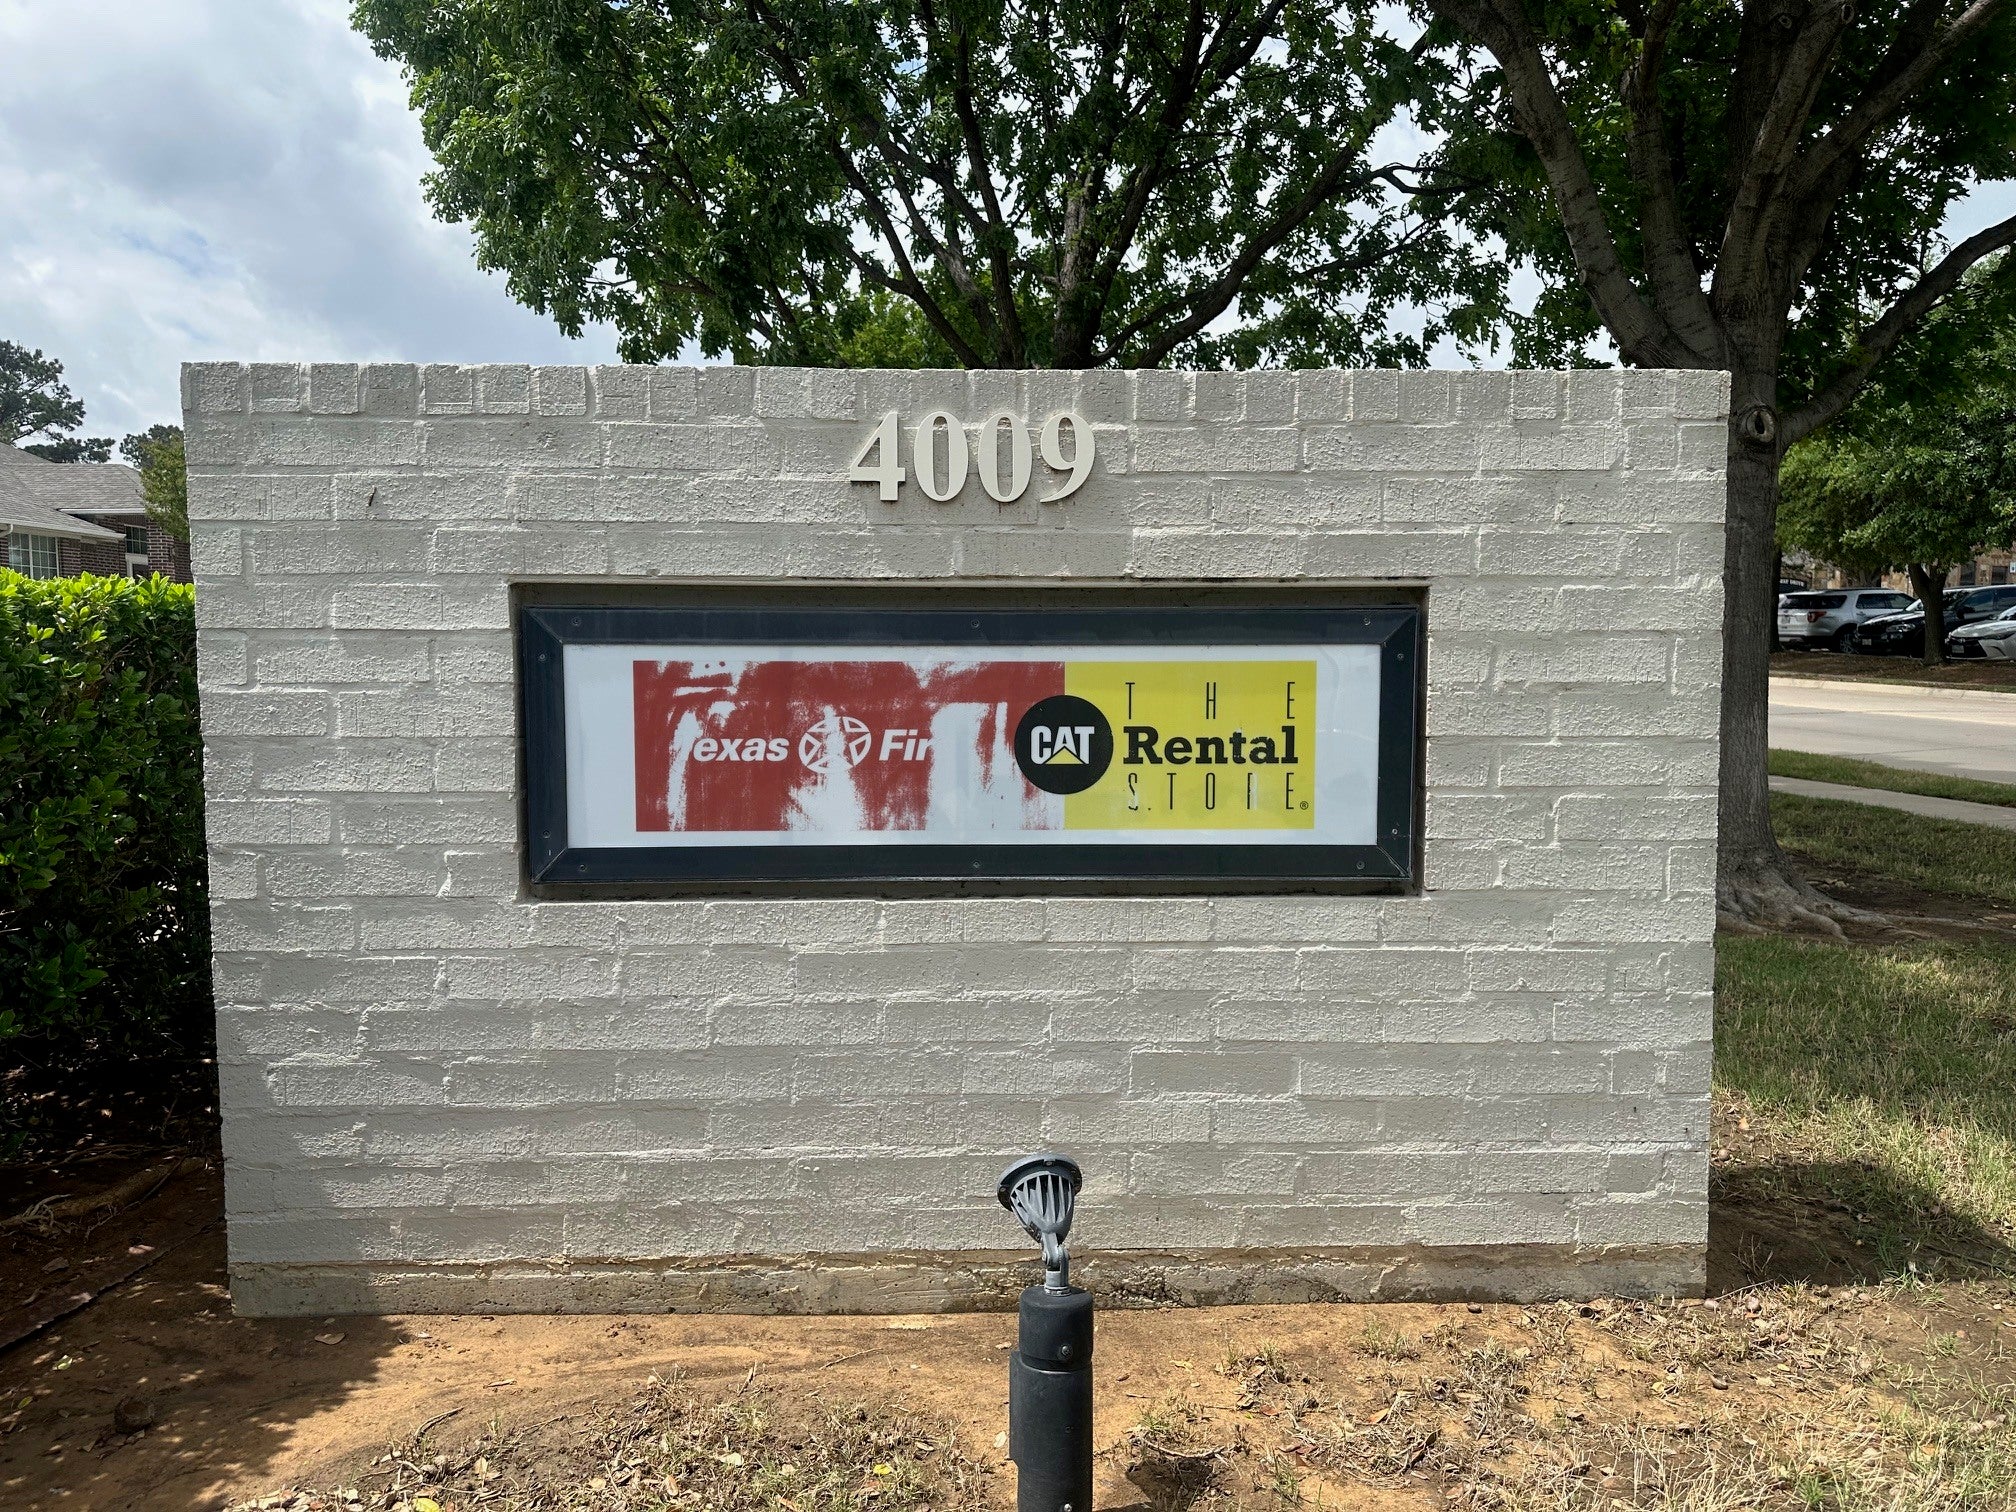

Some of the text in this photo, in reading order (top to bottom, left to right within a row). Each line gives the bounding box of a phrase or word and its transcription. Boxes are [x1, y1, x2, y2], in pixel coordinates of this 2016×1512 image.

[850, 410, 1096, 503] 4009
[1125, 681, 1296, 721] THE
[1030, 725, 1096, 765] CAT
[1122, 725, 1299, 765] Rental
